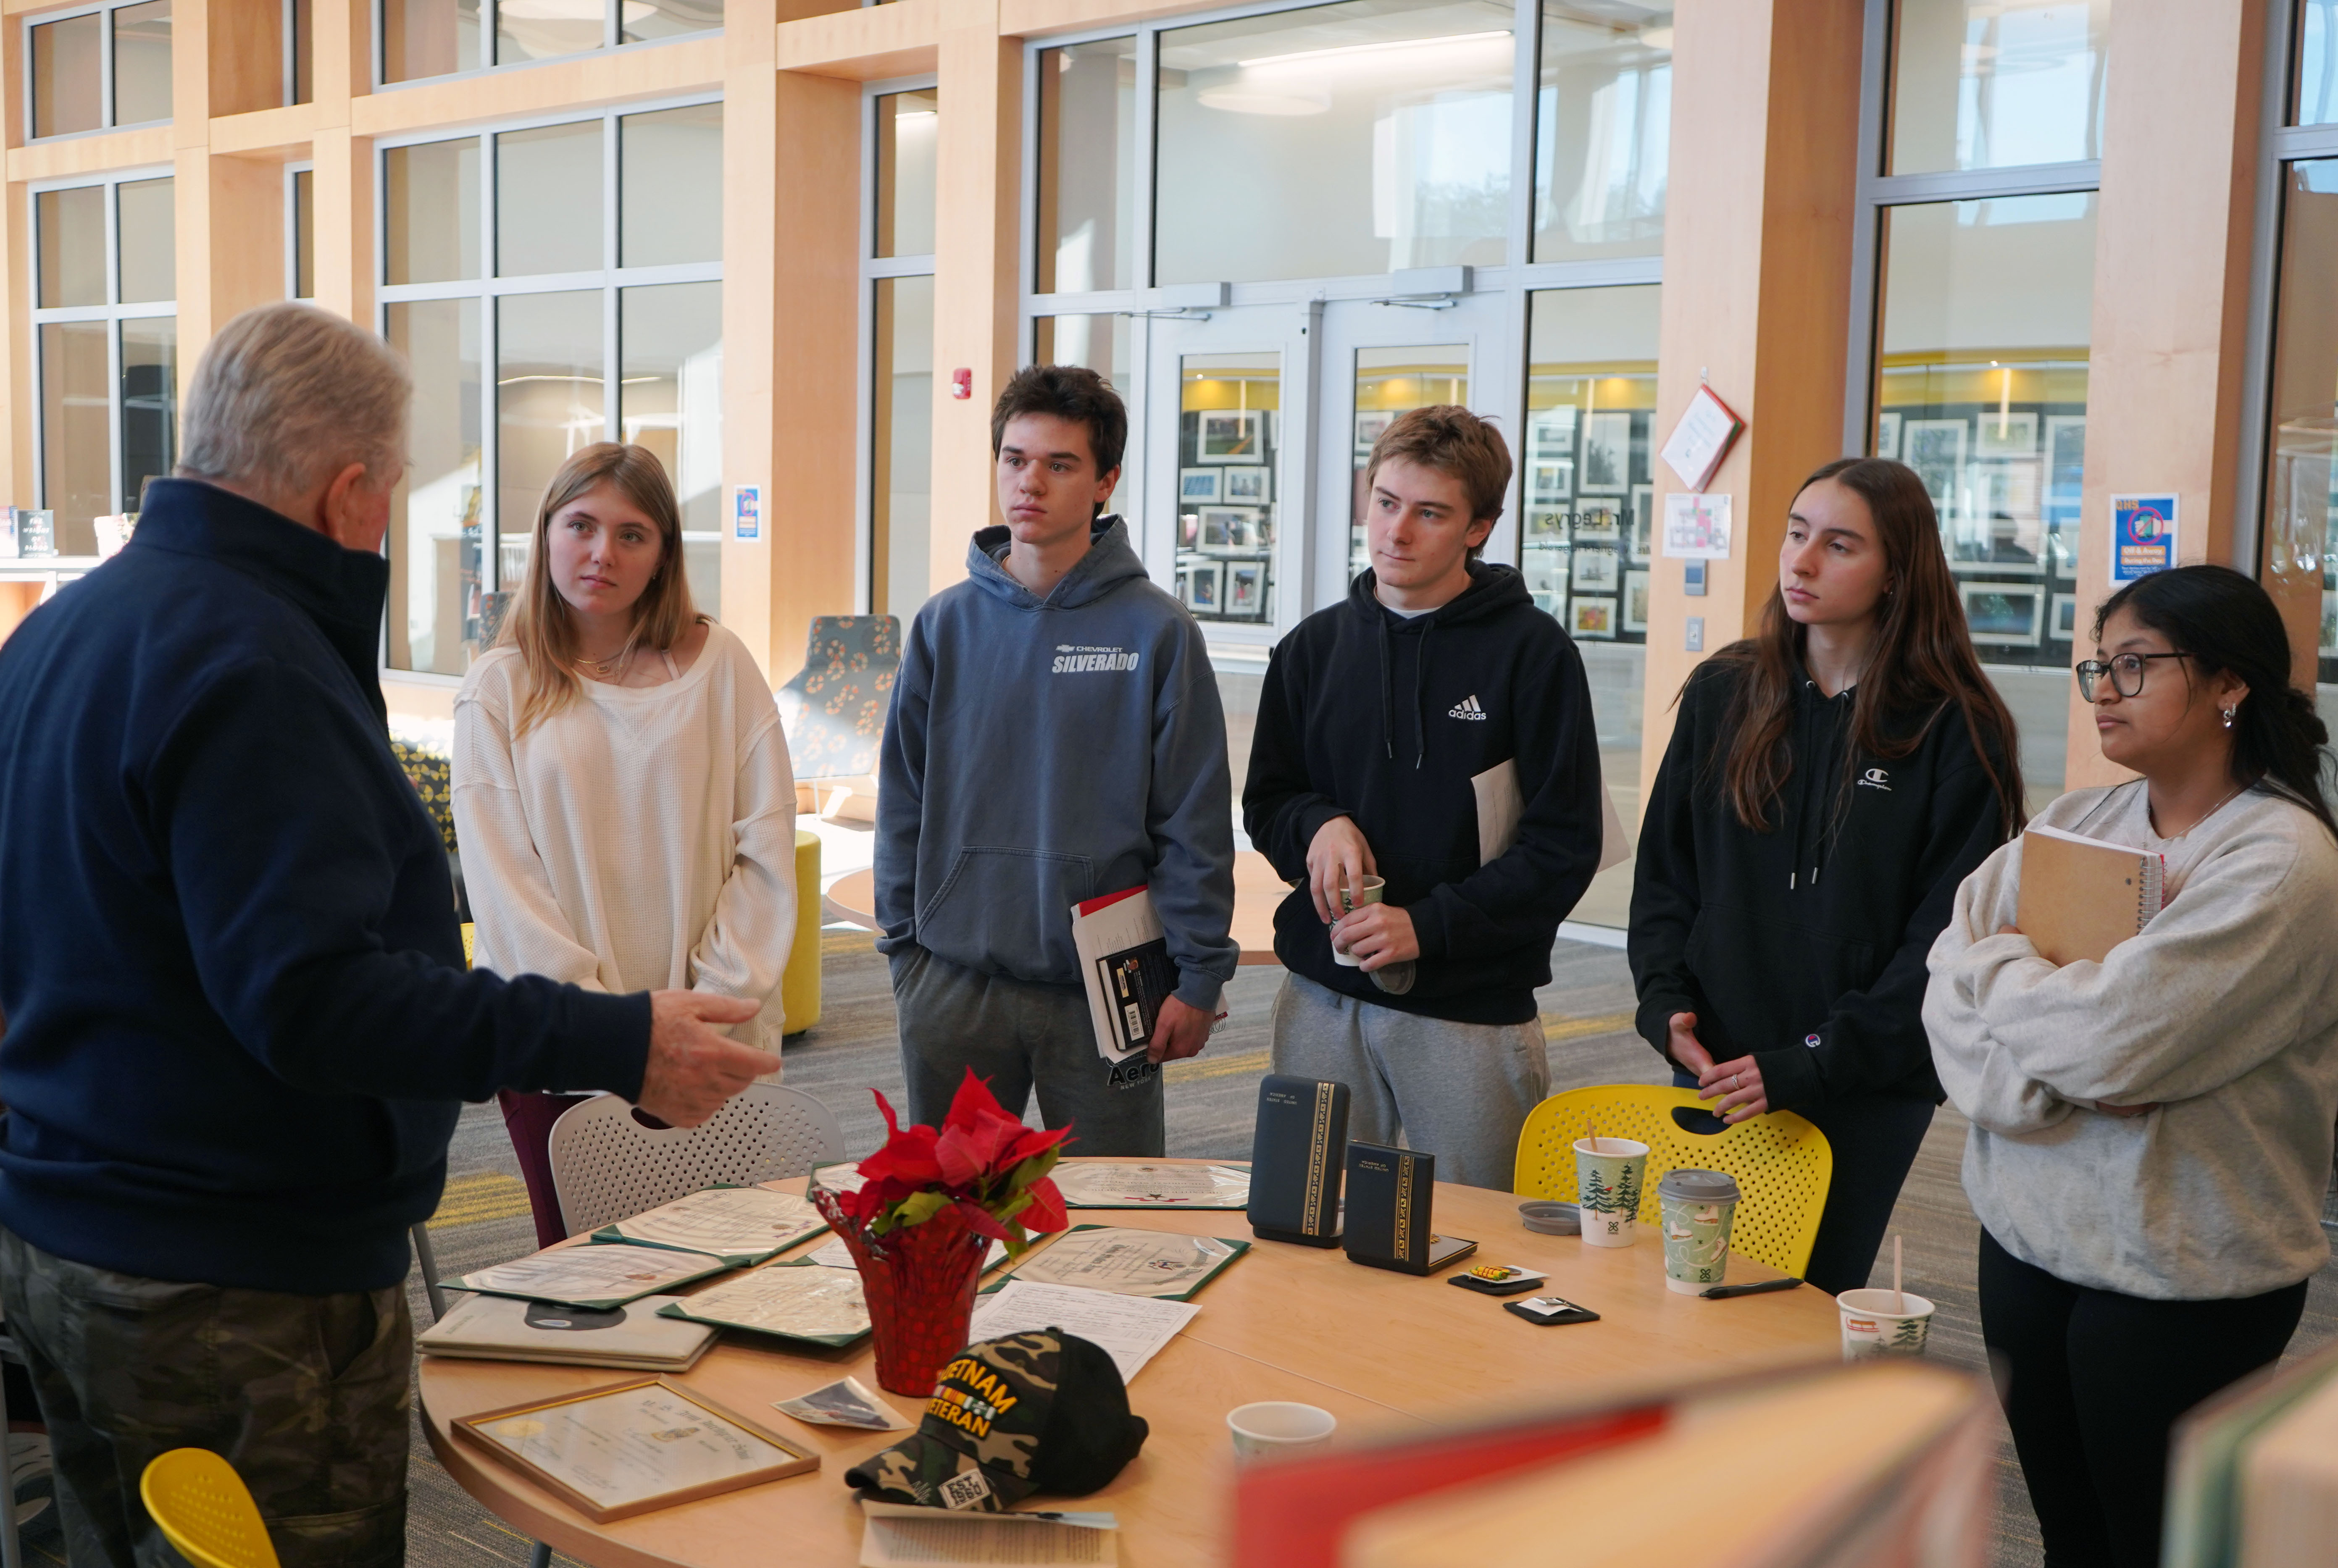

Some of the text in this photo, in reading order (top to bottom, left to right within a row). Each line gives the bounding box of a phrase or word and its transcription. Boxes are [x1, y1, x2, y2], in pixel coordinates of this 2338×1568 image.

[1052, 652, 1139, 673] SILVERADO
[1449, 709, 1486, 720] adidas
[1857, 779, 1892, 791] Champion
[1137, 1077, 1152, 1085] YORK
